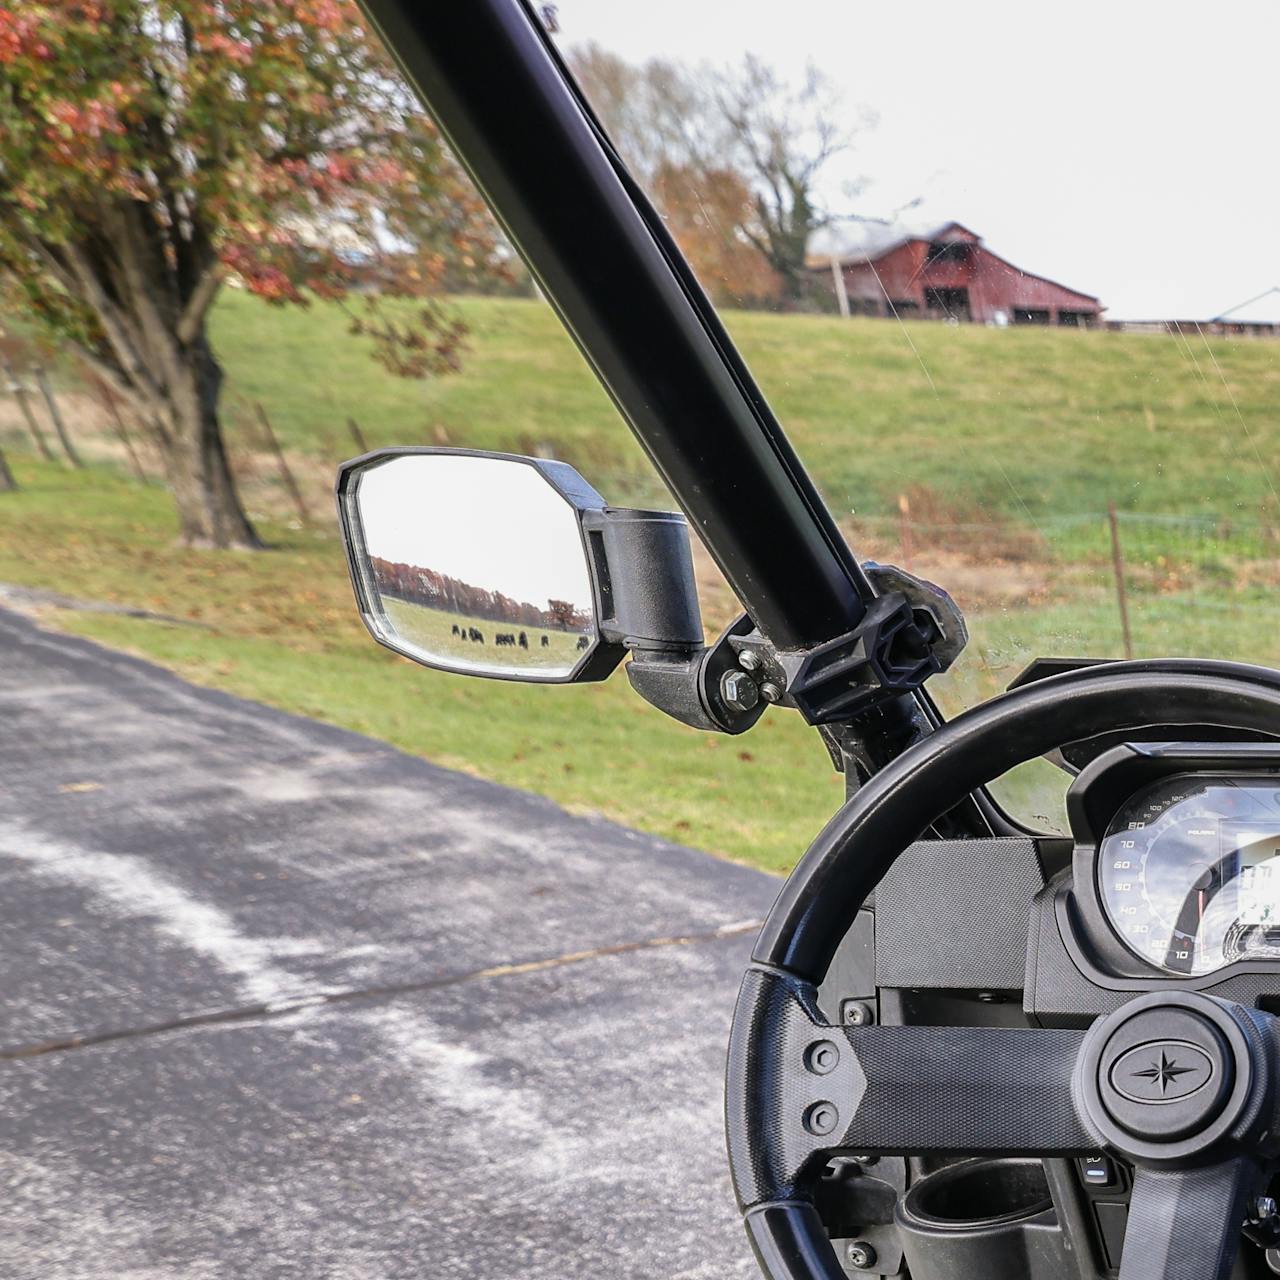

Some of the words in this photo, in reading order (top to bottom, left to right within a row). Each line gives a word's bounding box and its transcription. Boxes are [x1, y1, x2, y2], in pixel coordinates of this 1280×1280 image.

[1128, 822, 1145, 830] 80
[1120, 840, 1135, 849] 70
[1113, 861, 1131, 869] 60
[1115, 883, 1131, 891] 50
[1120, 906, 1136, 915] 40
[1131, 925, 1149, 933] 30
[1175, 951, 1189, 959] 10
